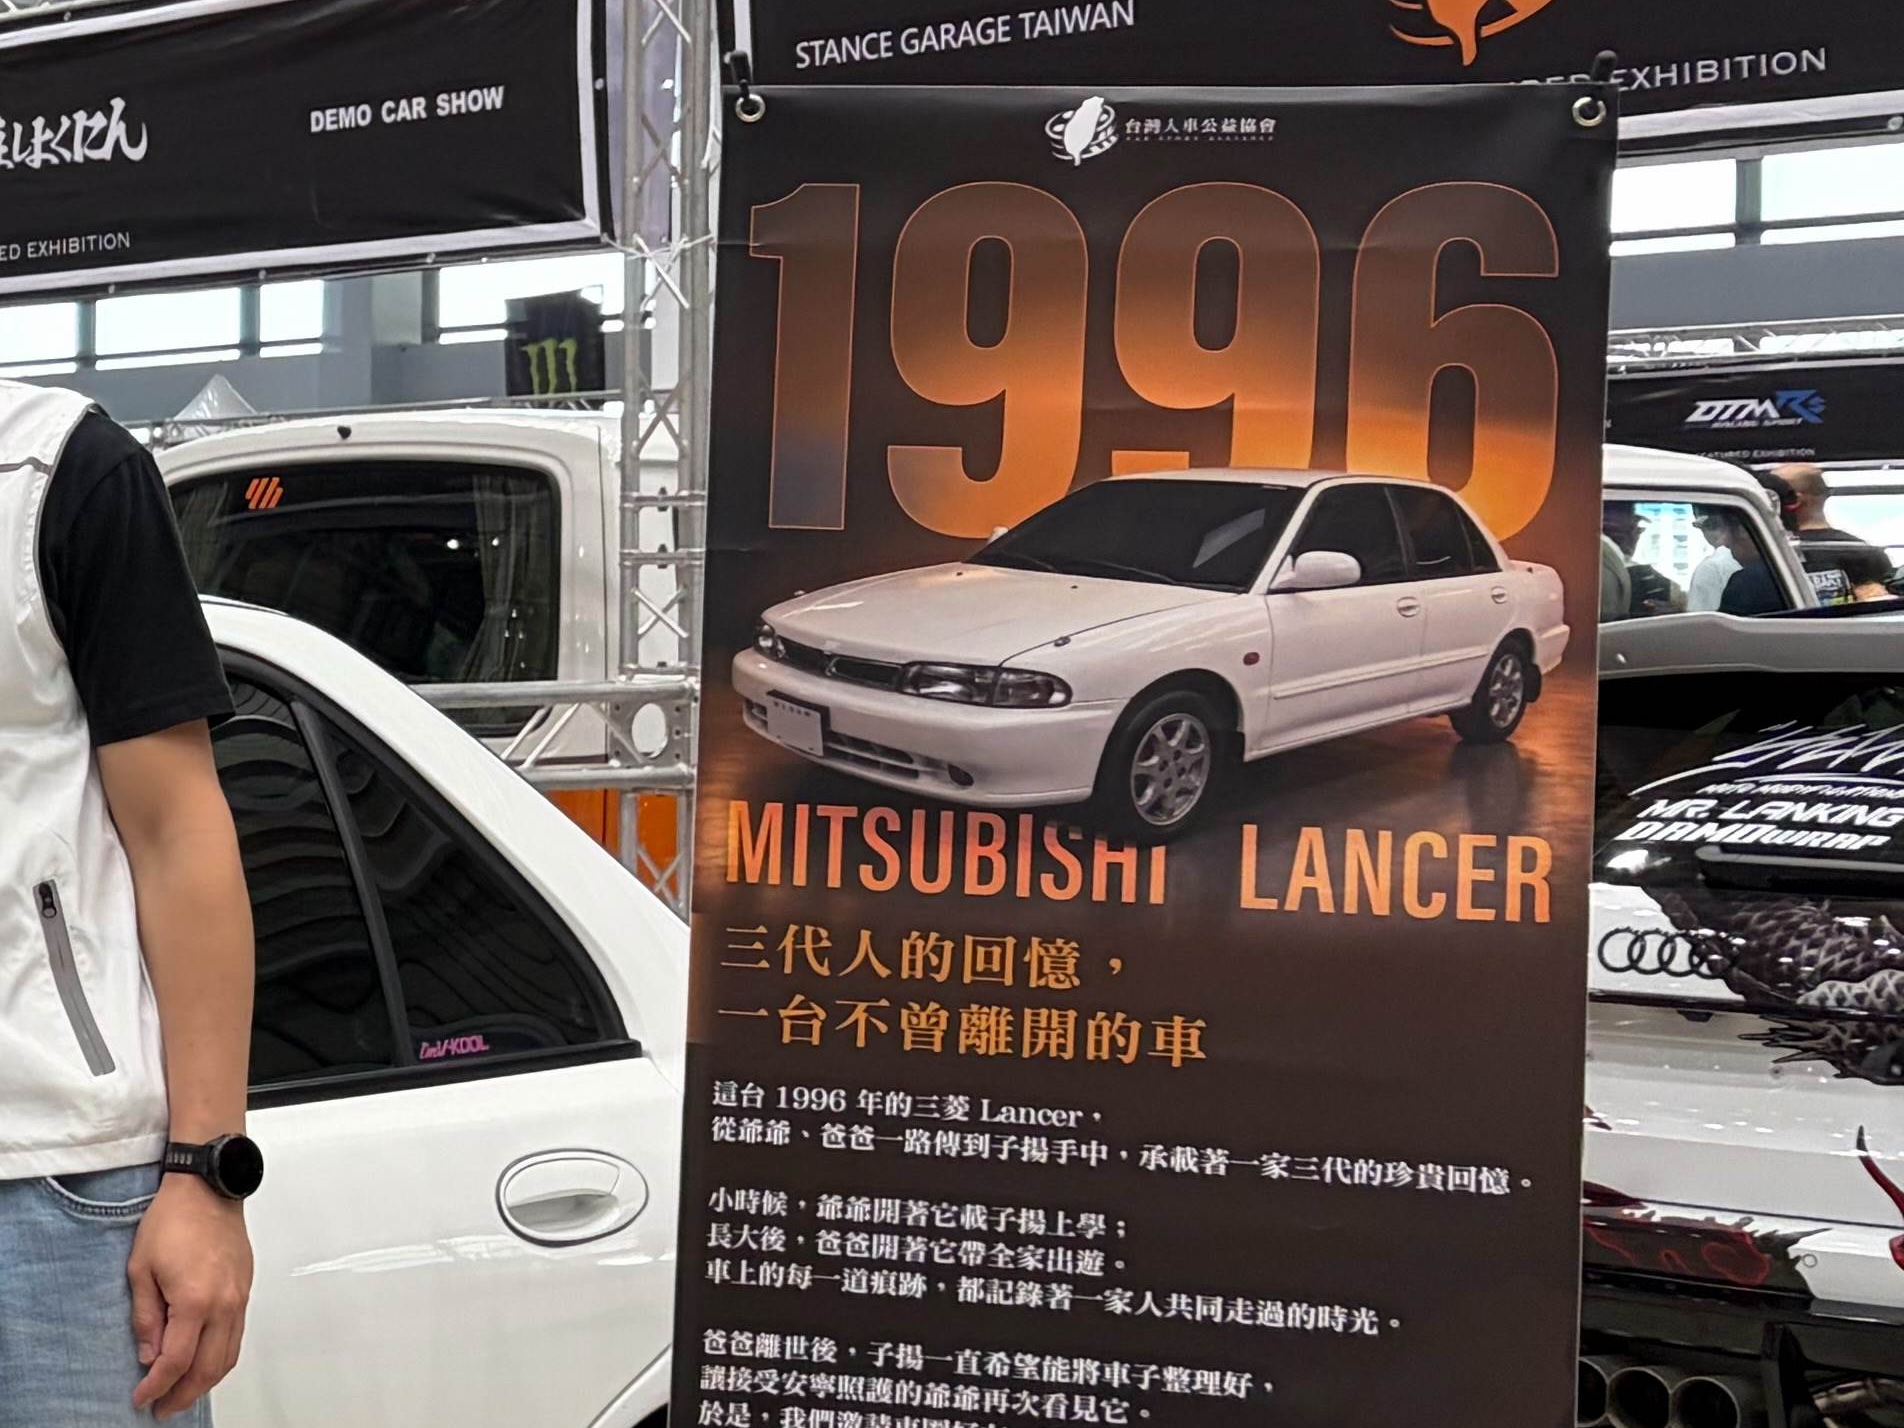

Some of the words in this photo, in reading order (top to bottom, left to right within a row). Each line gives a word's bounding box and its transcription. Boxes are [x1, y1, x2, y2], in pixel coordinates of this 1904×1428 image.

[796, 31, 893, 69] STANCE
[901, 15, 1011, 56] GARAGE
[1610, 47, 1827, 93] EXHIBITION
[310, 104, 372, 133] DEMO
[381, 97, 427, 123] CAR
[436, 85, 505, 116] SHOW
[1126, 118, 1277, 134] 台灣人車公益協會
[27, 232, 132, 260] EXHIBITION
[750, 181, 1559, 543] 1996
[727, 800, 1166, 906] MITSUBISHI
[1241, 823, 1553, 925] LANCER
[720, 924, 1125, 992] 三代人的回憶，
[718, 994, 1208, 1068] 一台不曾離開的車
[712, 1080, 764, 1109] 這台
[776, 1086, 846, 1112] 1996
[857, 1089, 970, 1122] 年的三菱
